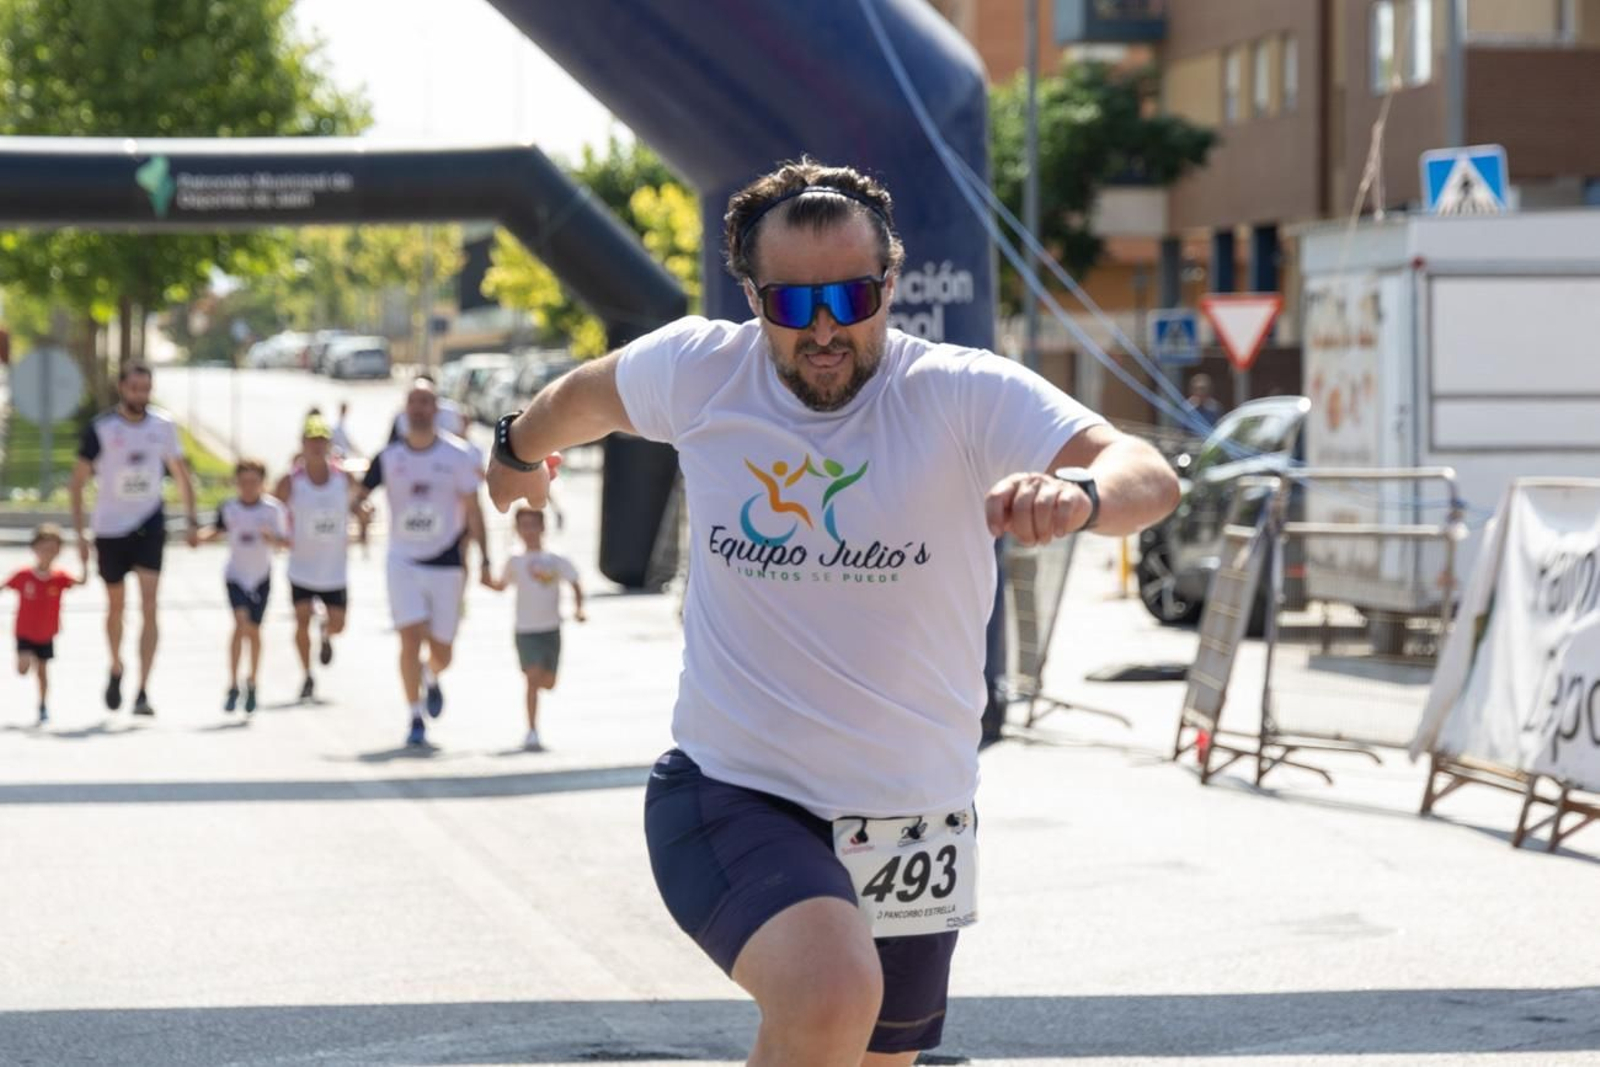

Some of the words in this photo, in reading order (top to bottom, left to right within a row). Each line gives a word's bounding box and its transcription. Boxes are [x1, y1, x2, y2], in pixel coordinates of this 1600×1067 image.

[709, 525, 808, 572] Equipo
[811, 570, 832, 582] SE
[842, 572, 900, 583] PUEDE
[861, 844, 957, 903] 493
[883, 907, 924, 920] PANCORBO
[924, 903, 957, 917] ESTRELLA
